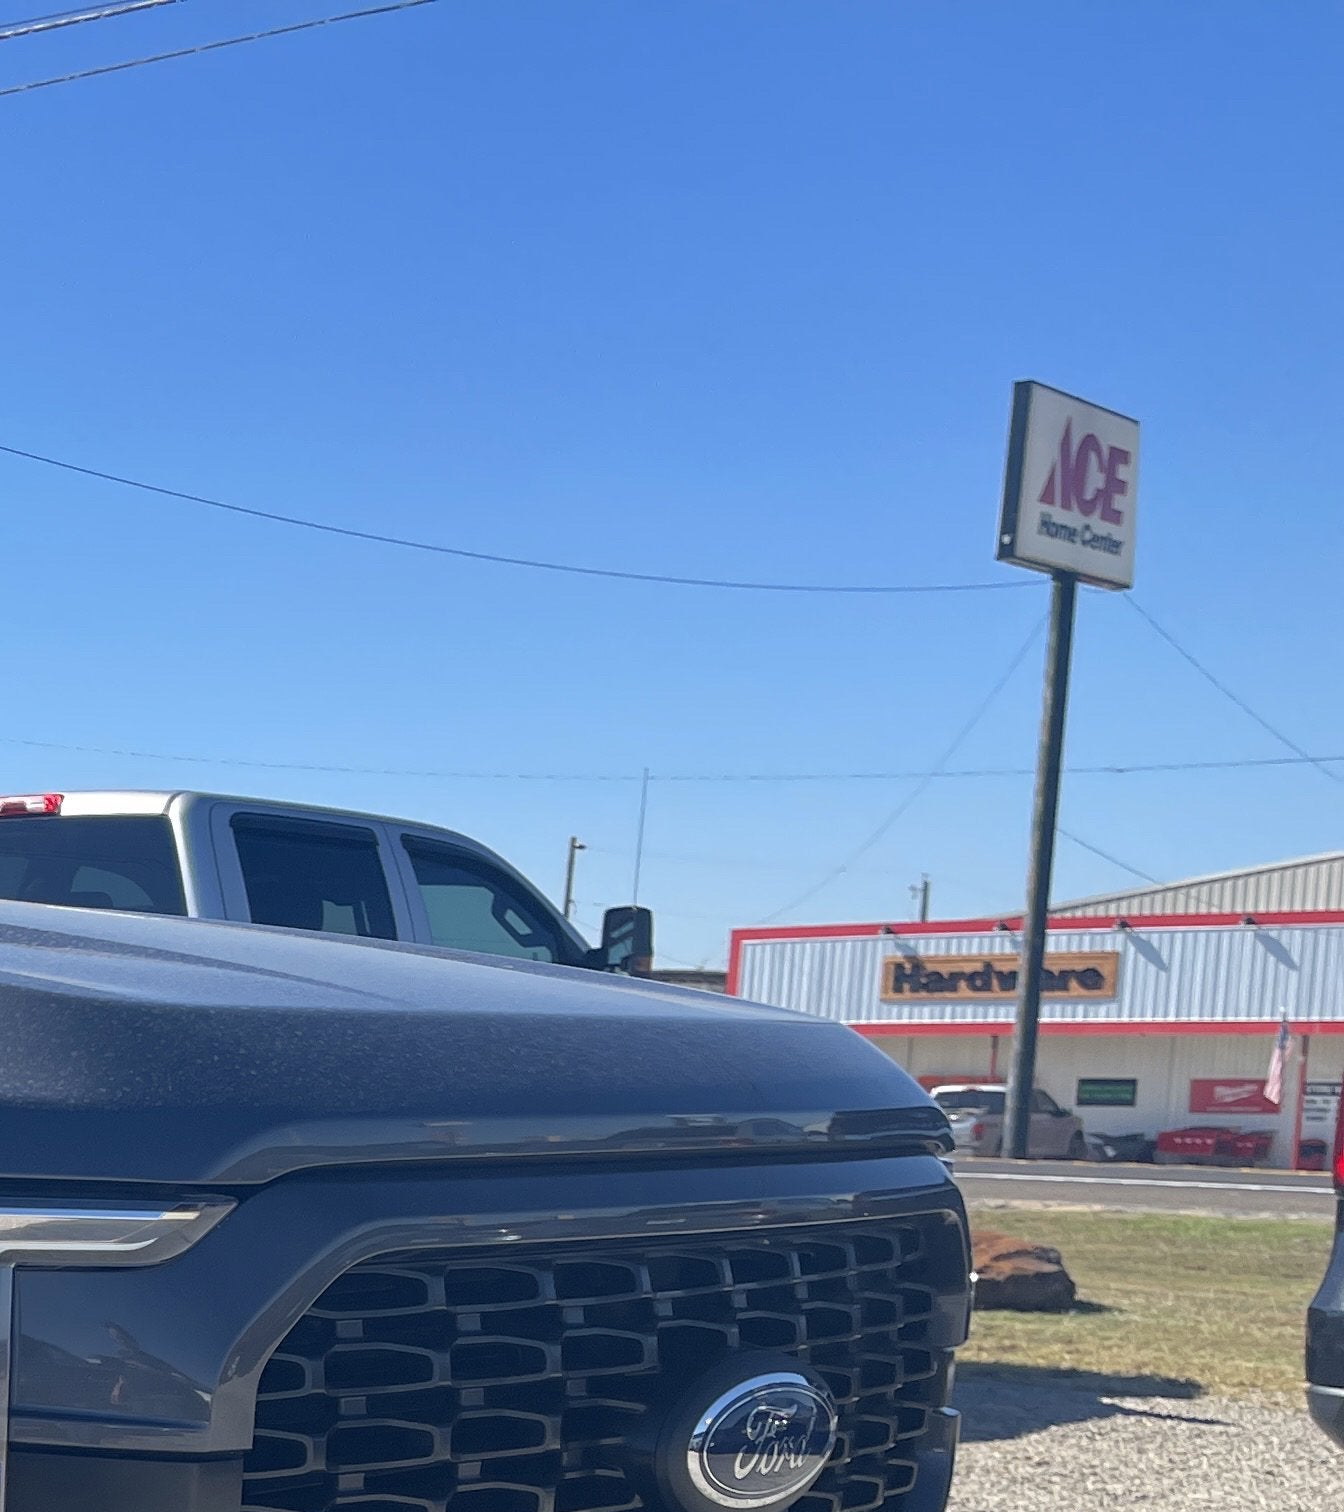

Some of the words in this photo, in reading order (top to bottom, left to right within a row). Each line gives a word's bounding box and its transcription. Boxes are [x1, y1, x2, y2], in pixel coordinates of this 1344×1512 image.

[1037, 416, 1131, 526] ACE
[1037, 512, 1077, 544] Home
[1080, 524, 1125, 556] Center
[734, 1402, 817, 1479] Ford
